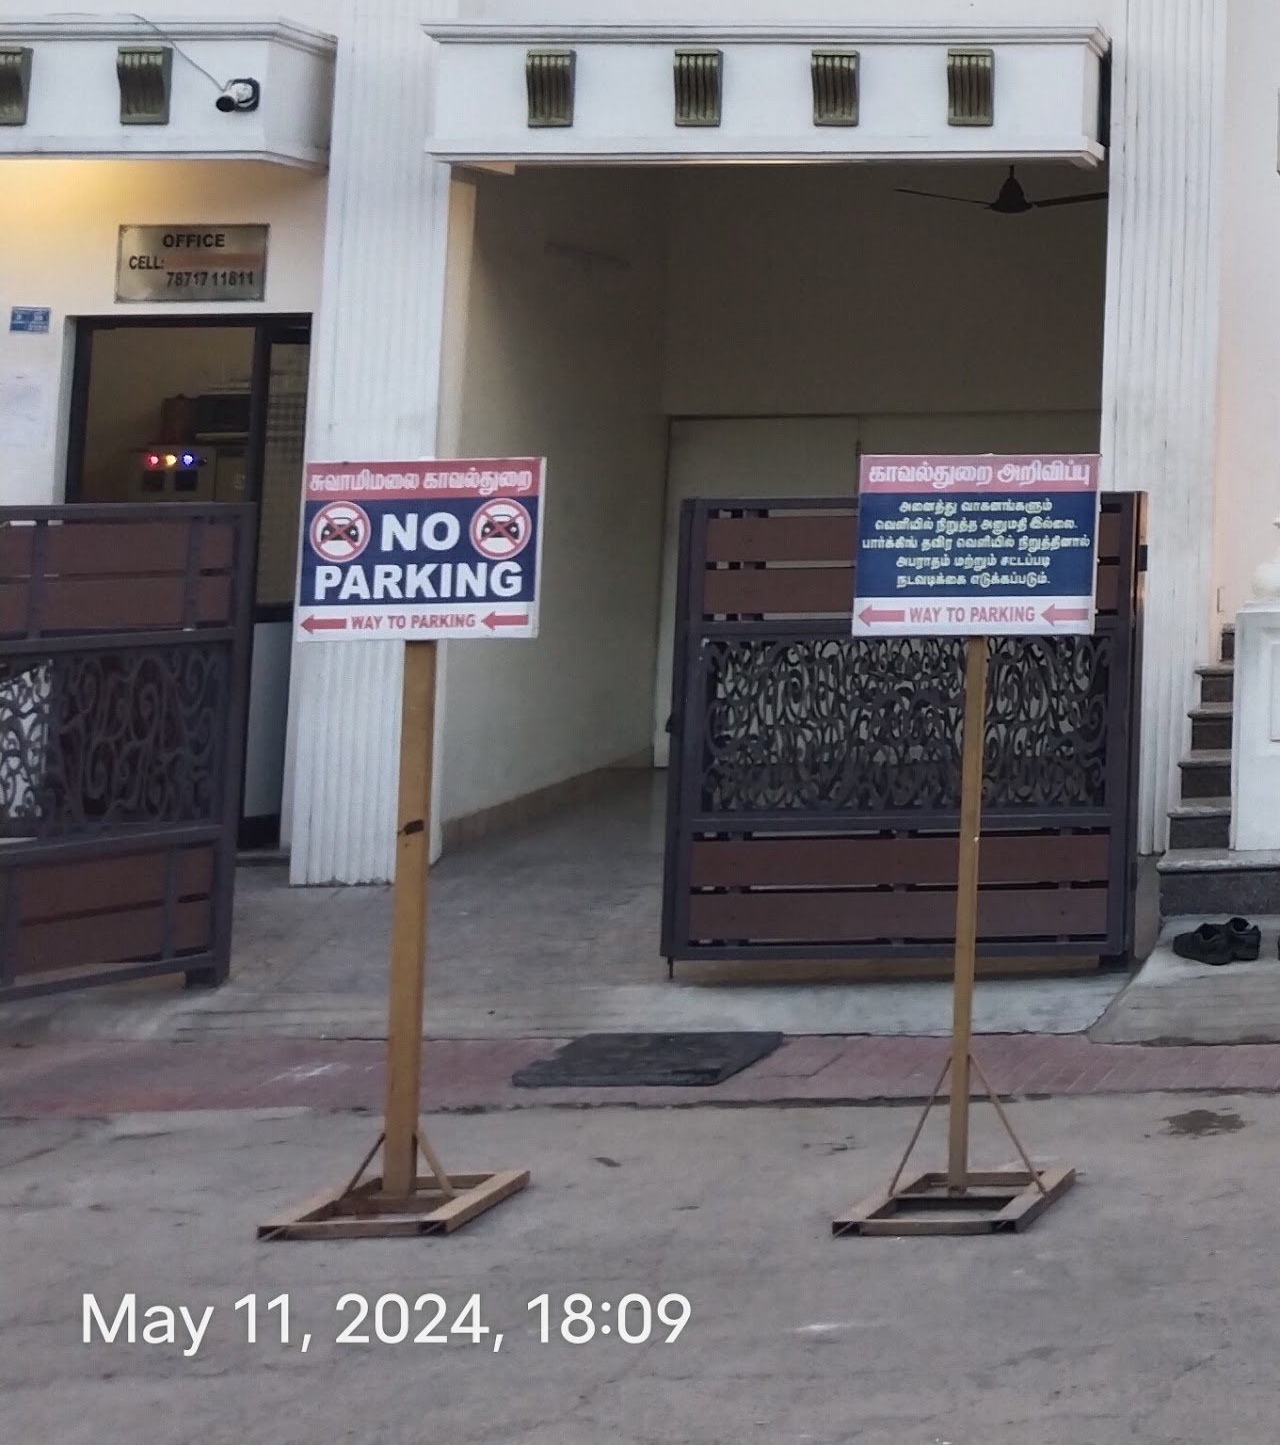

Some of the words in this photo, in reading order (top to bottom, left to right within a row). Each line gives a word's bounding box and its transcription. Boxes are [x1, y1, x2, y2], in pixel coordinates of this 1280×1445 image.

[163, 234, 225, 248] OFFICE
[129, 256, 165, 270] CELL:
[423, 466, 532, 495] காவல்துறை
[868, 461, 993, 489] காவல்துறை
[997, 459, 1090, 486] அறிவிப்பு
[899, 499, 957, 516] அனைத்து
[961, 498, 1053, 514] வாகனங்களும்
[380, 512, 460, 552] NO
[875, 517, 933, 531] வெளியில்
[935, 517, 978, 535] நிறுத்த
[980, 517, 1027, 535] அனுமதி
[862, 536, 918, 549] பார்க்கிங்
[921, 535, 953, 551] தவிர
[956, 535, 1015, 549] வெளியில்
[1018, 533, 1090, 553] நிறுத்தினால்
[896, 554, 950, 570] அபராதம்
[954, 553, 997, 571] மற்றும்
[1001, 553, 1051, 568] சட்டப்படி
[314, 561, 523, 600] PARKING
[896, 572, 966, 588] நடவடிக்கை
[351, 615, 383, 630] WAY
[387, 615, 407, 629] TO
[411, 614, 476, 629] PARKING
[910, 607, 941, 623] WAY
[947, 607, 965, 622] TO
[970, 606, 1035, 623] PARKING
